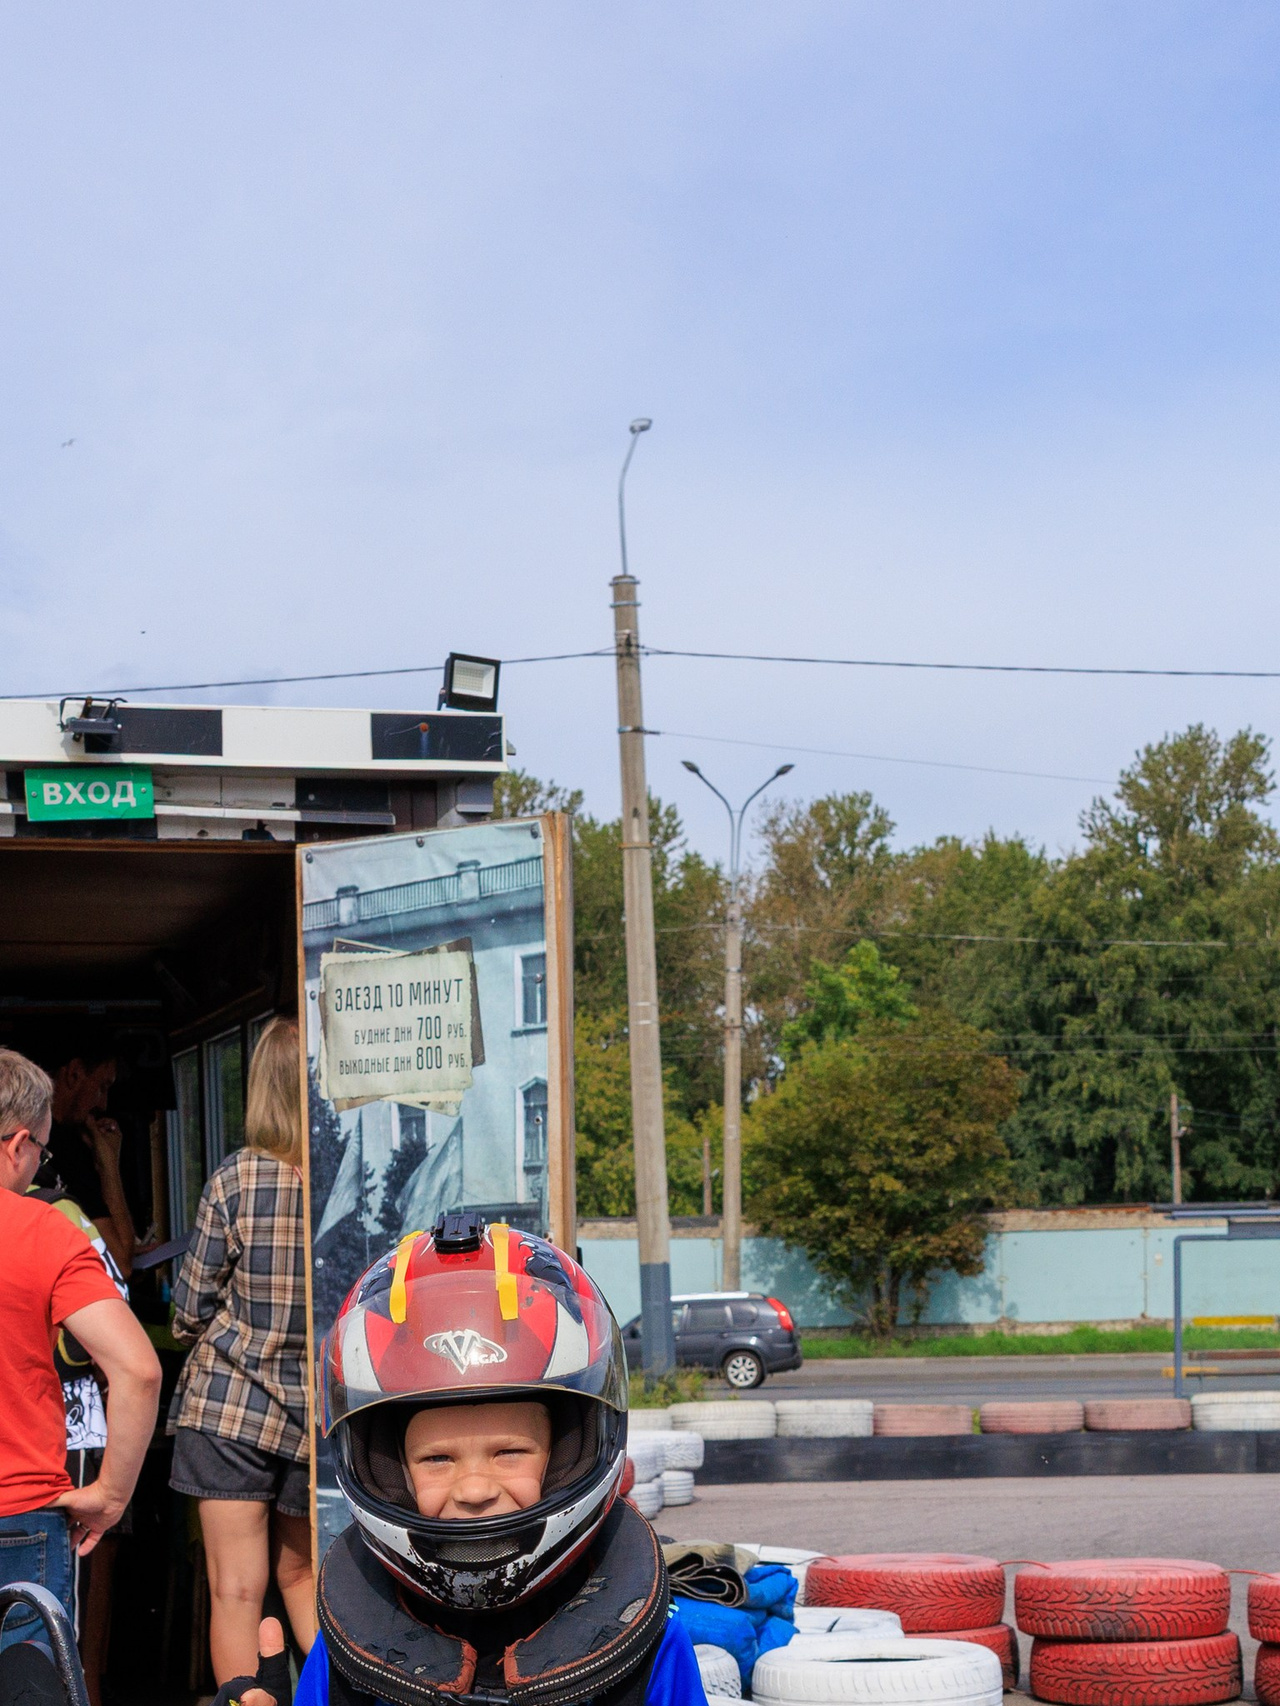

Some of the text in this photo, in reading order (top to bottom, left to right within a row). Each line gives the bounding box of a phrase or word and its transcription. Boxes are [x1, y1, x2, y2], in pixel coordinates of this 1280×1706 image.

[43, 781, 137, 808] ВХОД
[335, 978, 463, 1012] ЗАЕЗД 10 МИНУТ
[354, 1015, 467, 1045] БУДНИЕ ДНИ 700 РУБ.
[340, 1045, 468, 1075] ВЫХОДНЫЕ ДНИ 800 РУБ.
